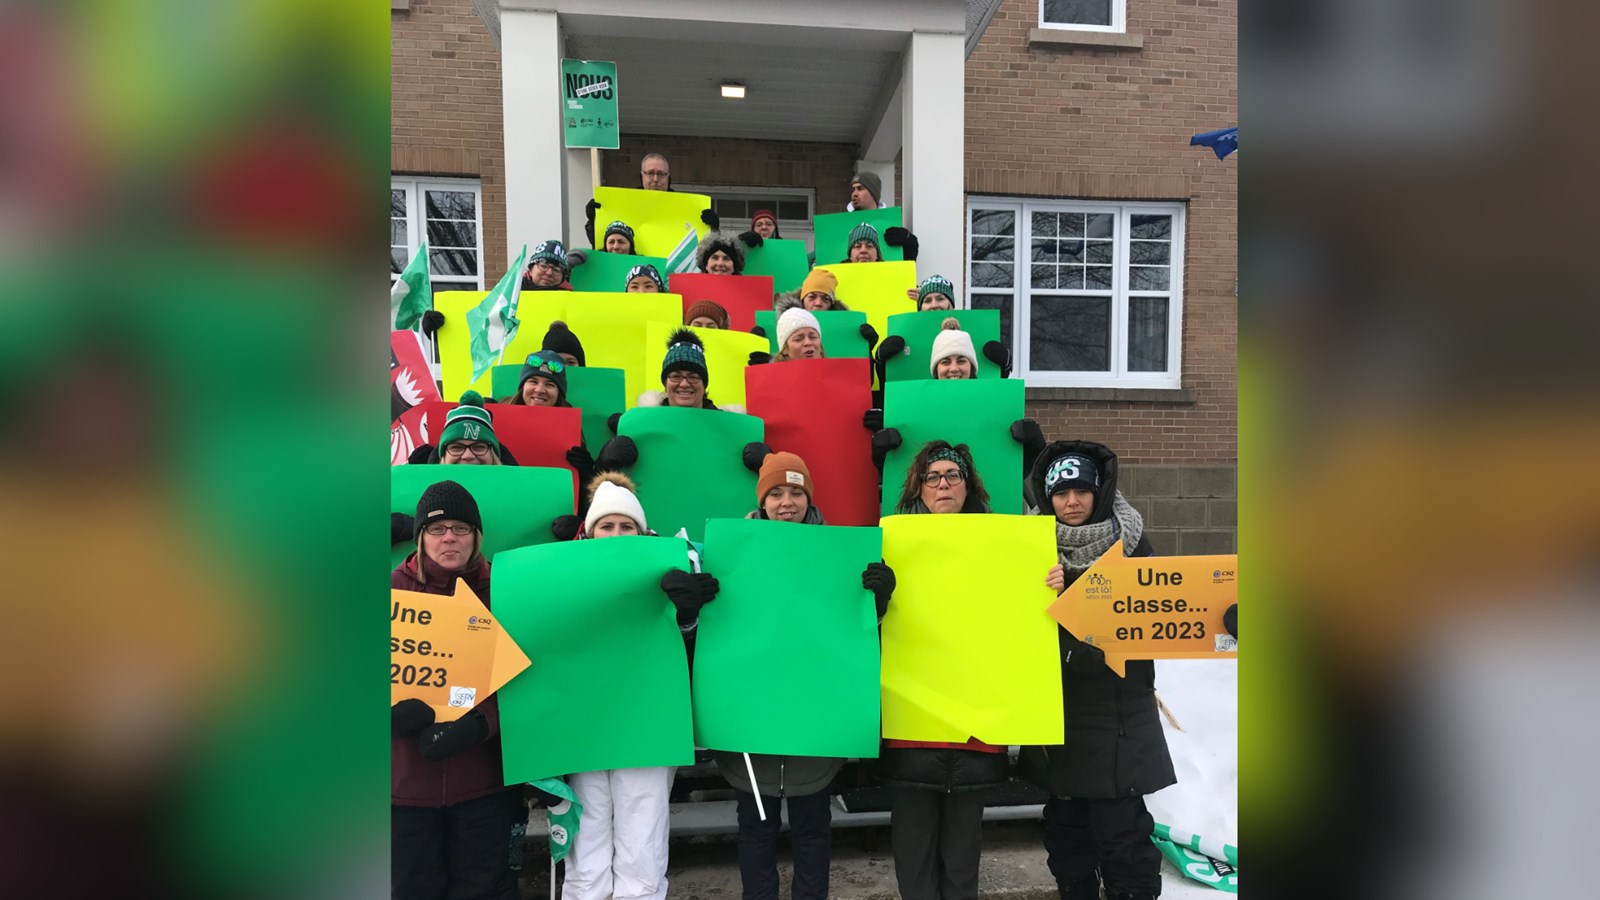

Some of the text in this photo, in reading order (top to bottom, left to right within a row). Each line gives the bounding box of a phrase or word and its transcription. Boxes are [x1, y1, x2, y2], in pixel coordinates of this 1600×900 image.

[566, 72, 613, 101] NOUS
[1138, 568, 1183, 586] Une
[1112, 596, 1208, 613] classe...
[1116, 626, 1143, 640] en
[1151, 621, 1206, 640] 2023
